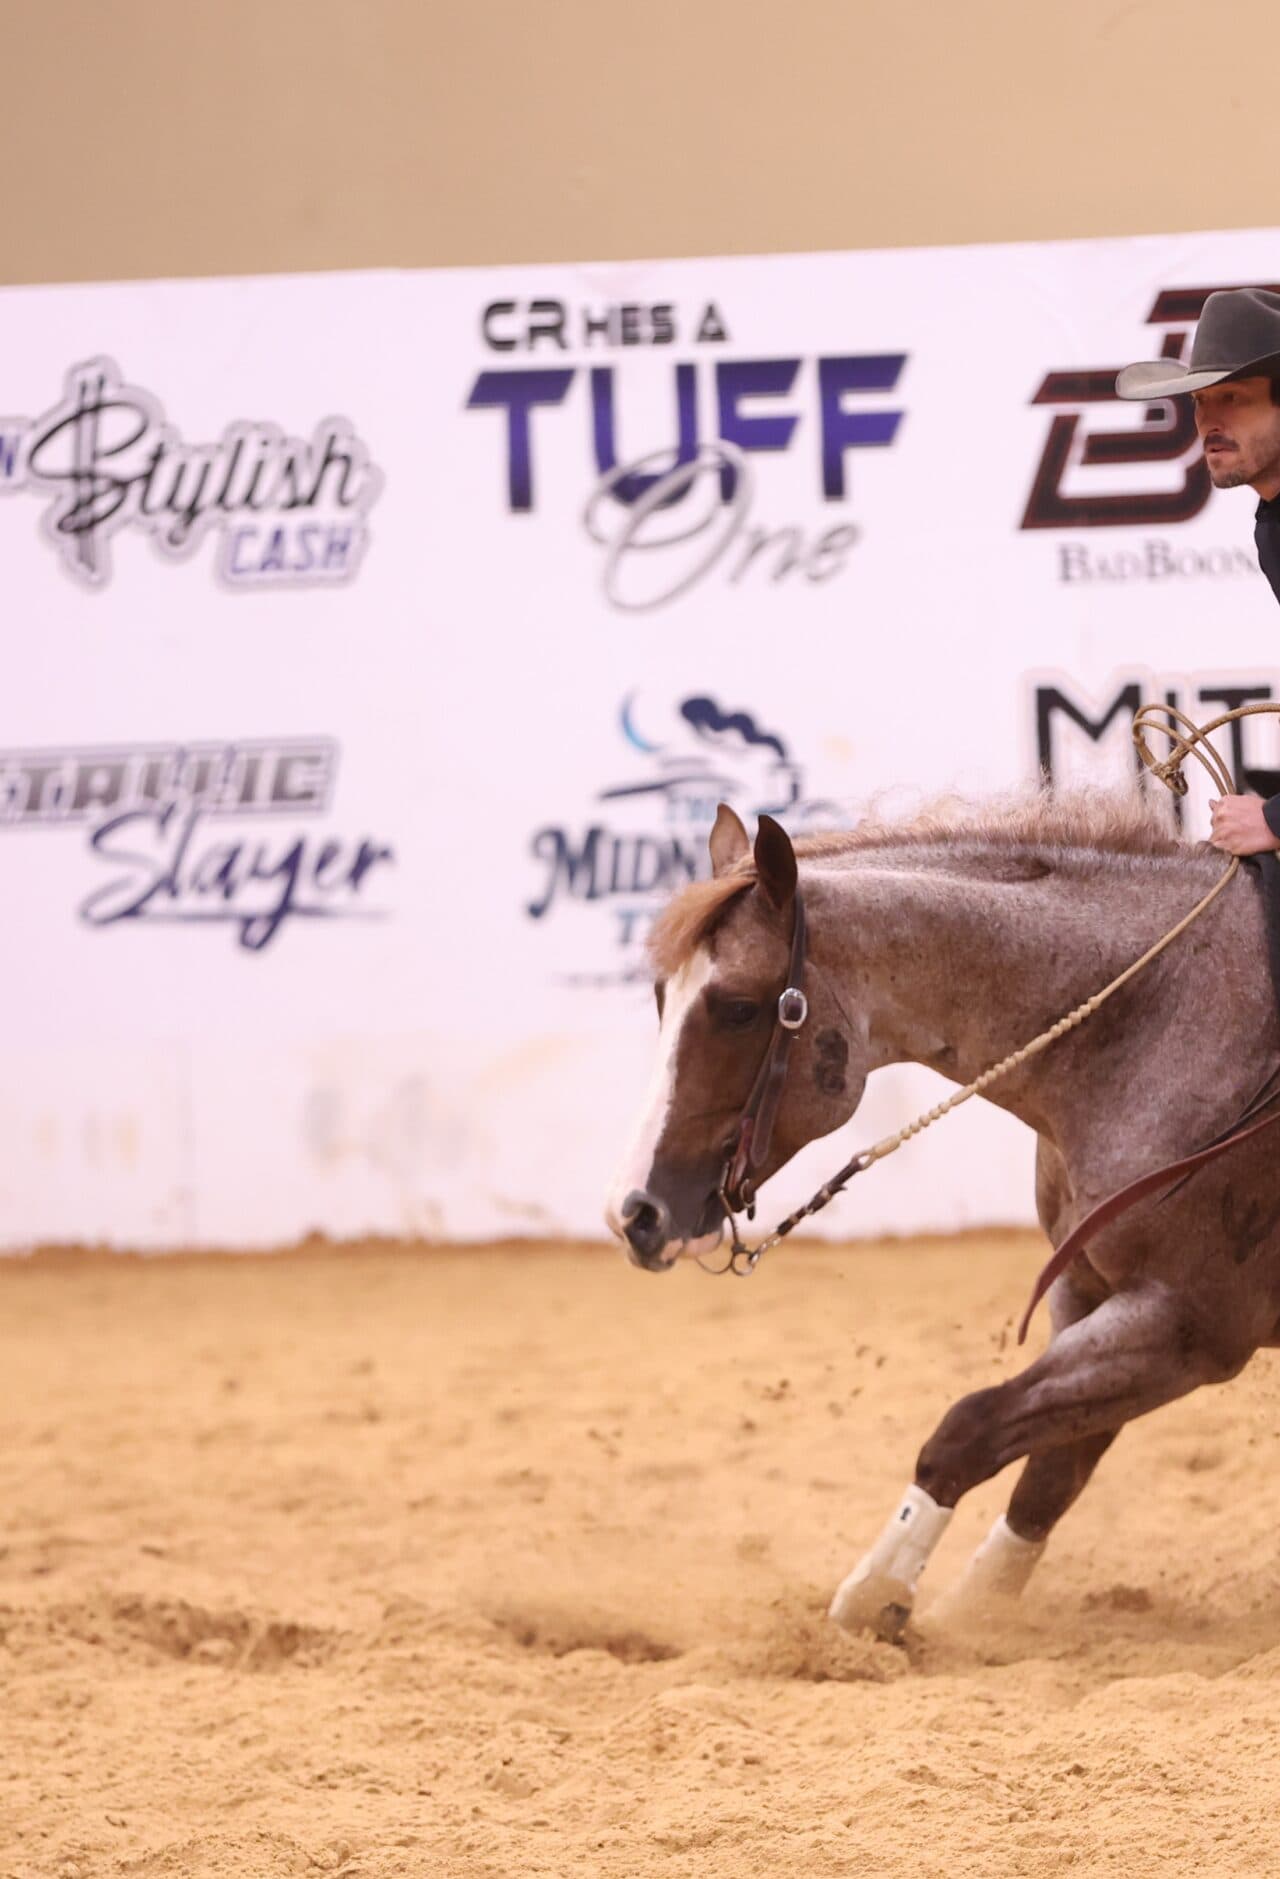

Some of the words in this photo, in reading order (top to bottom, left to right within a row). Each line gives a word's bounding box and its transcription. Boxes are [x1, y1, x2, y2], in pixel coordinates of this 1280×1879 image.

[697, 302, 729, 342] A
[466, 354, 908, 513] TUFF
[230, 527, 351, 576] CASH
[583, 439, 863, 615] One
[80, 800, 395, 950] Slayer
